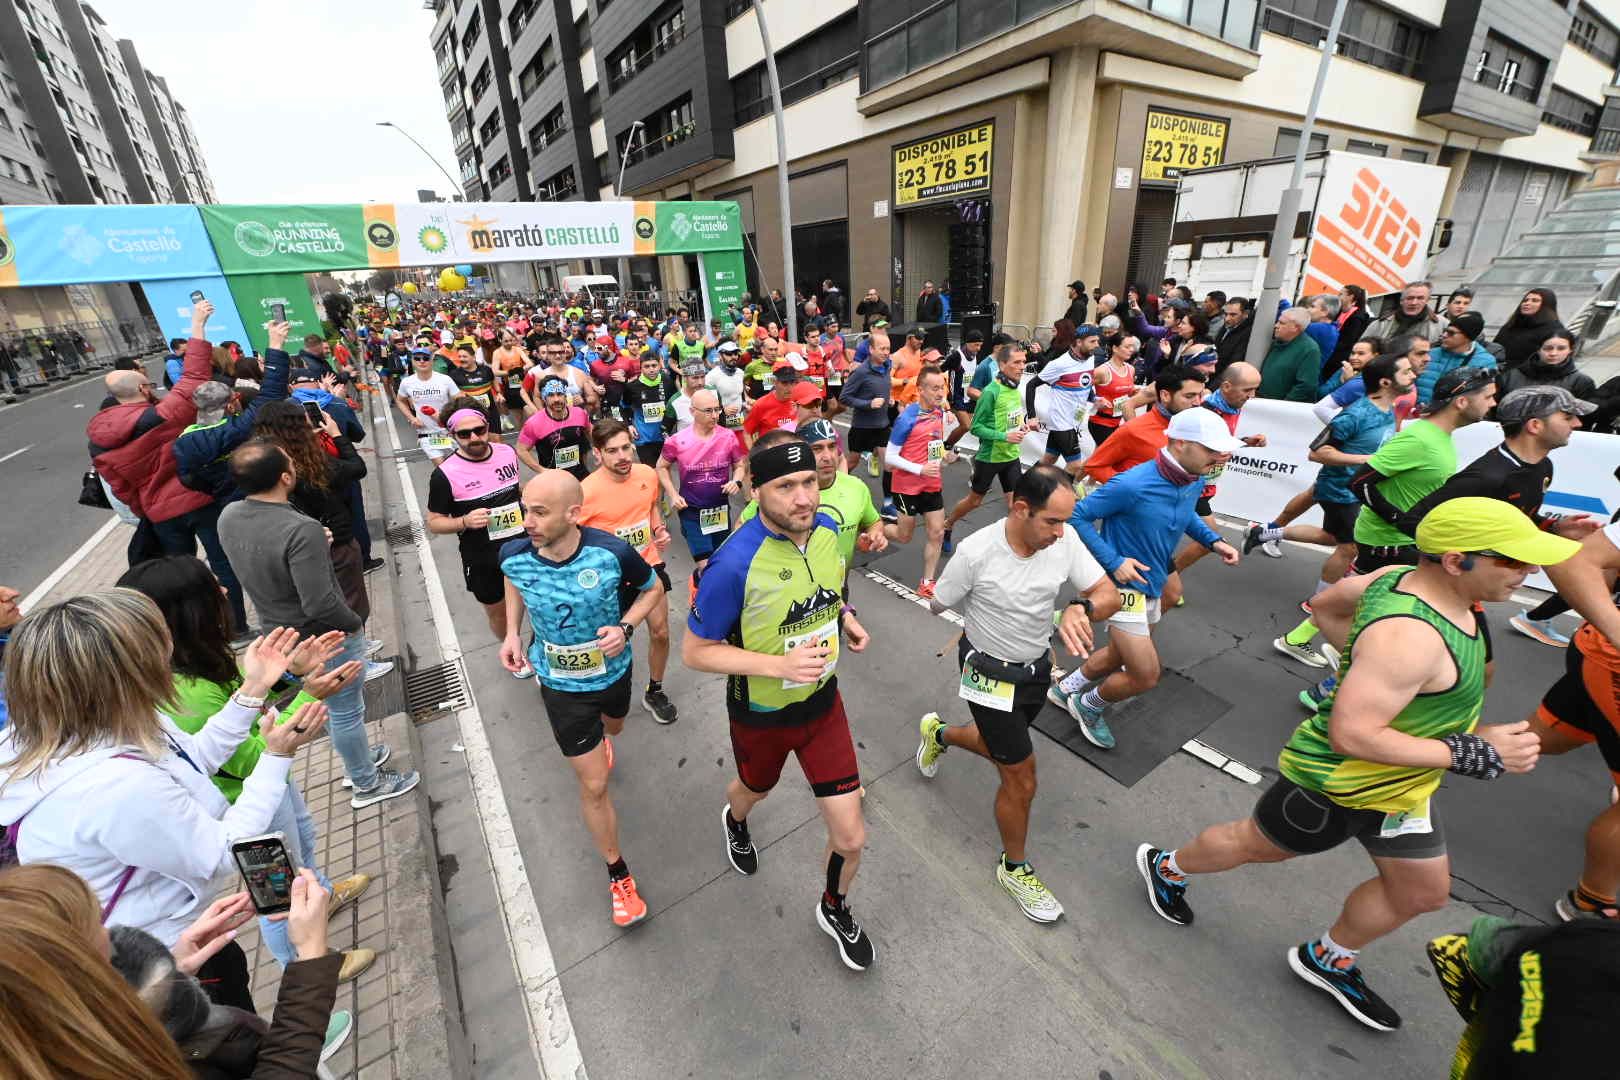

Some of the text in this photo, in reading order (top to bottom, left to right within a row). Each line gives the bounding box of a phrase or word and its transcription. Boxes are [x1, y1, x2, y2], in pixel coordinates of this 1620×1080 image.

[1150, 115, 1222, 137] DISPONIBLE
[899, 128, 987, 163] DISPONIBLE
[1152, 140, 1172, 163] 23
[1180, 143, 1197, 165] 78
[1202, 146, 1220, 166] 51
[905, 166, 926, 188] 23
[933, 158, 956, 183] 78
[964, 151, 988, 175] 51
[273, 228, 340, 242] RUNNING
[471, 221, 620, 249] marató CASTELLÓ
[1227, 465, 1273, 479] Transportes
[1228, 455, 1298, 475] MONFORT
[495, 511, 516, 527] 746
[624, 530, 644, 545] 719
[555, 602, 577, 629] 2
[557, 652, 591, 667] 623
